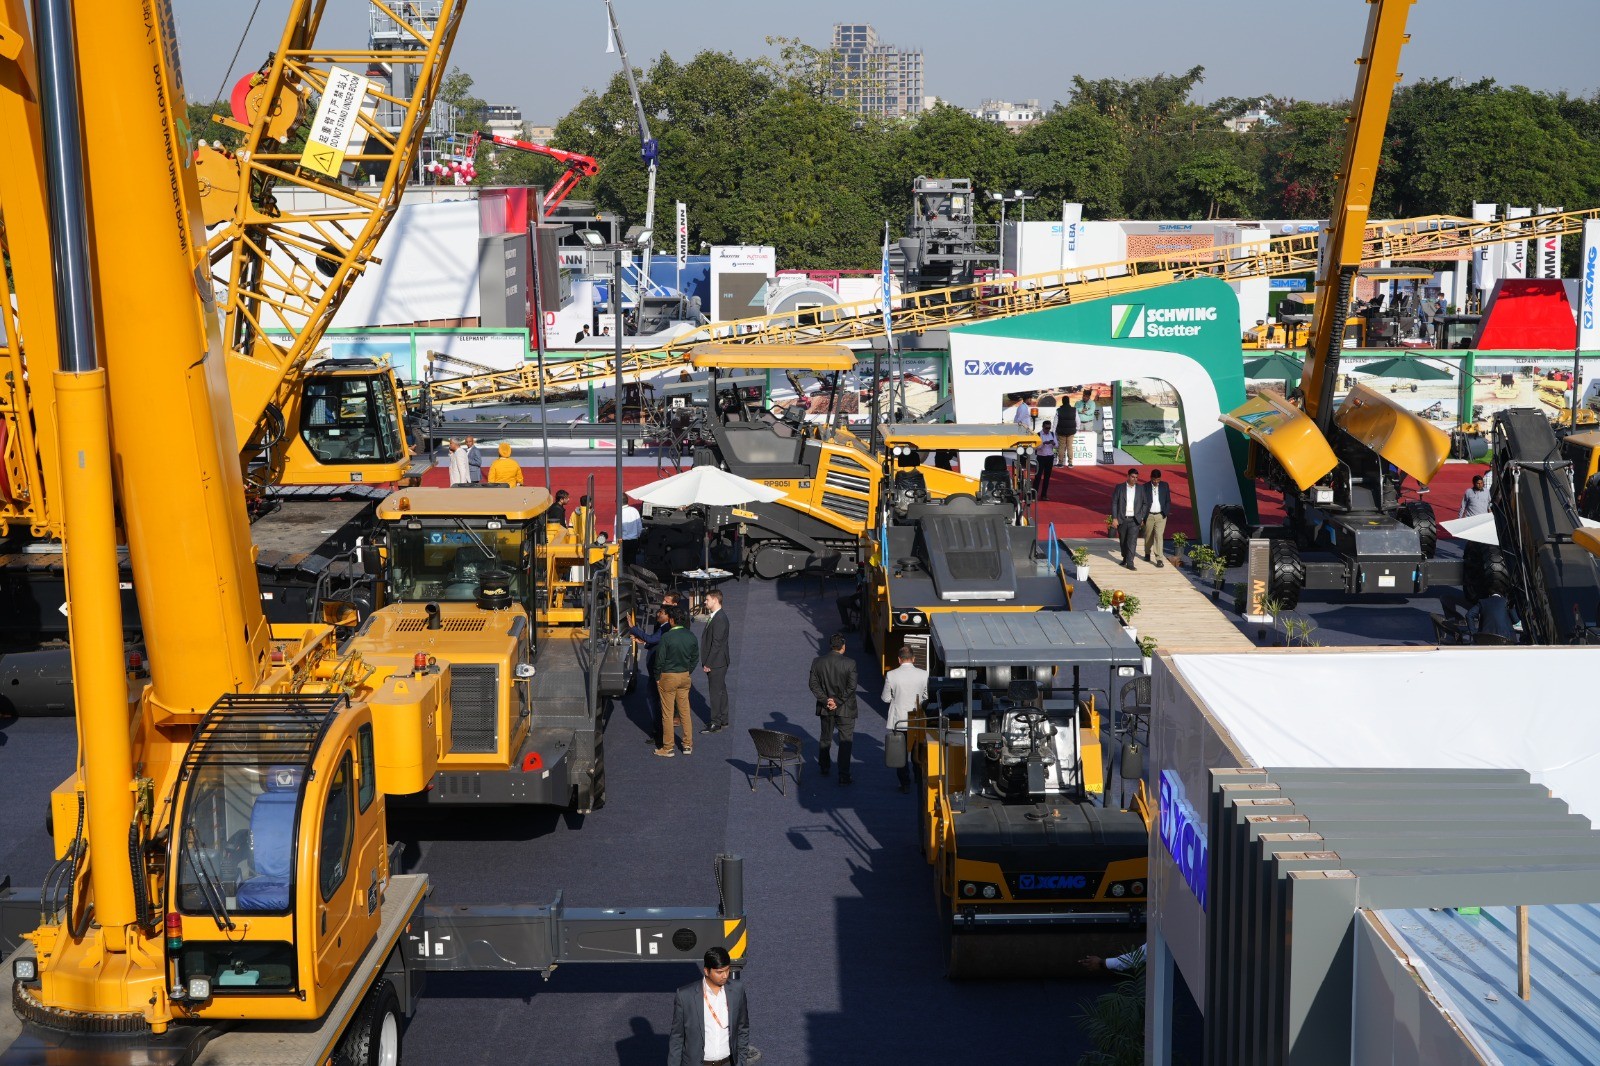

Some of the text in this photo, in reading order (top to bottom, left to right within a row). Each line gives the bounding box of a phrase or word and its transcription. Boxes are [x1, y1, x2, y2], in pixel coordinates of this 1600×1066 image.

[153, 64, 162, 86] DO
[157, 86, 166, 113] NOT
[329, 75, 360, 148] DO NOT STAND UNDER BOOM
[161, 116, 173, 160] STAND
[168, 161, 180, 208] UNDER
[1068, 223, 1077, 251] ELBA
[1271, 279, 1307, 288] SIMEM
[1585, 246, 1598, 310] XCMG
[1146, 307, 1218, 322] SCHWING
[1147, 324, 1202, 337] Stetter
[980, 361, 1034, 376] XCMG
[1035, 875, 1087, 889] XCMG
